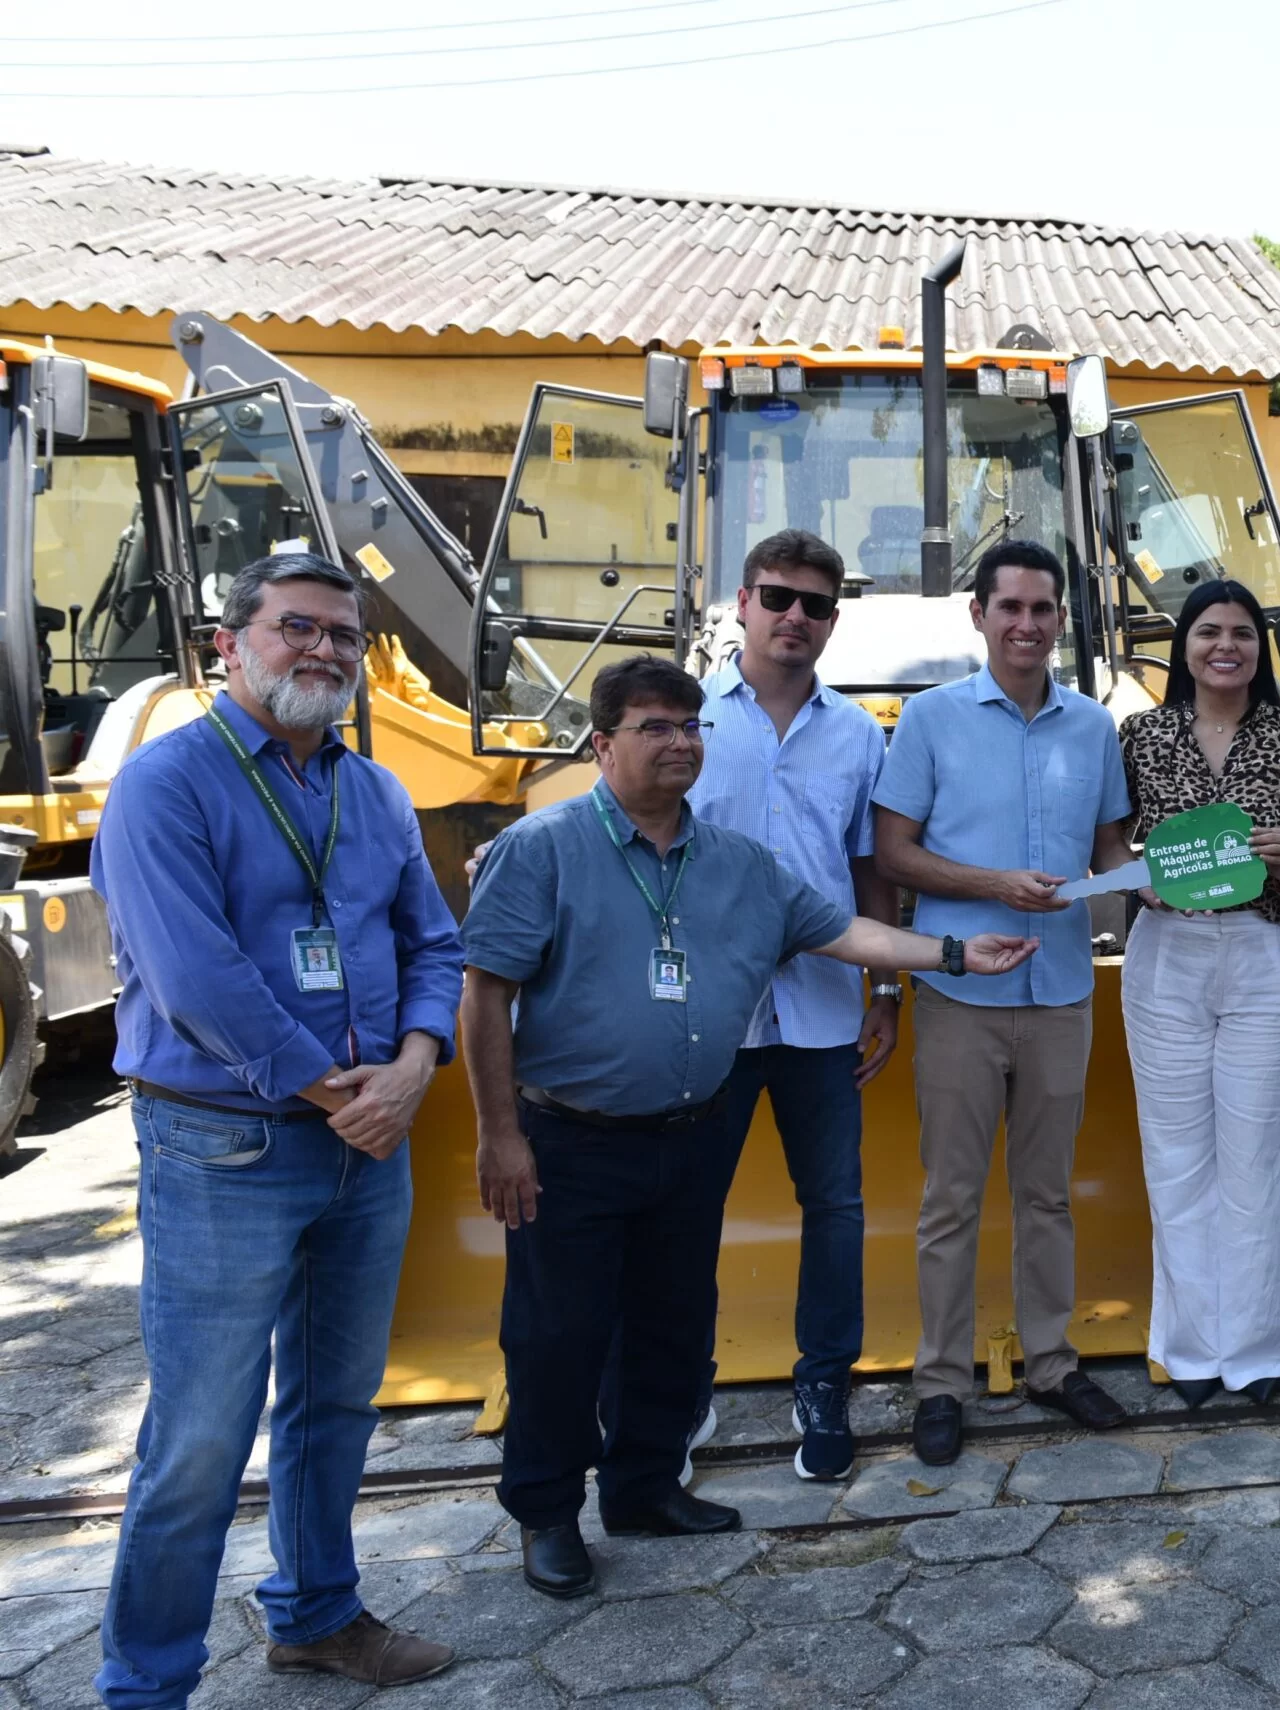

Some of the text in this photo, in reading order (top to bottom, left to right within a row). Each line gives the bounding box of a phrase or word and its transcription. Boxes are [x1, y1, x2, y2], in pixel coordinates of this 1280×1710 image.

[1149, 838, 1208, 858] Entrega de
[1160, 850, 1211, 868] Máquinas
[1217, 854, 1252, 867] PROMAQ
